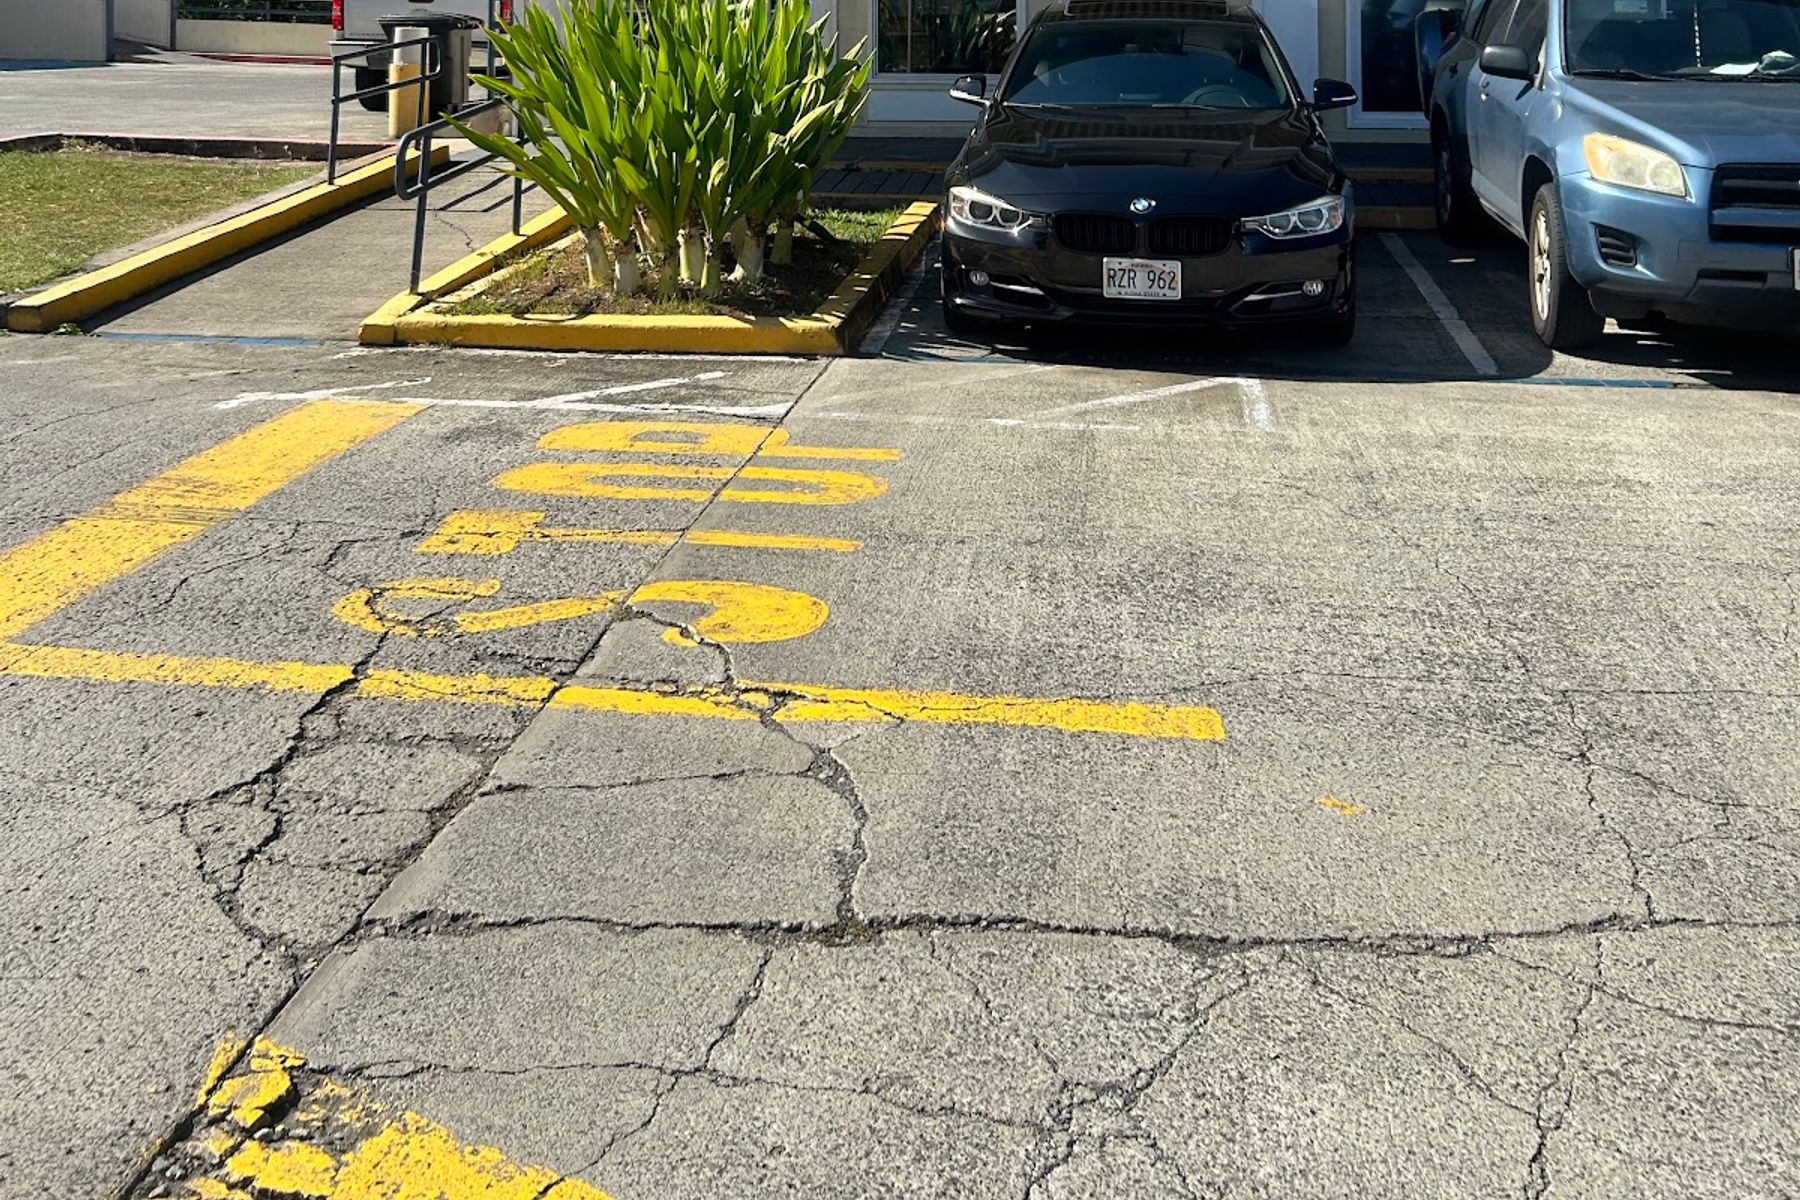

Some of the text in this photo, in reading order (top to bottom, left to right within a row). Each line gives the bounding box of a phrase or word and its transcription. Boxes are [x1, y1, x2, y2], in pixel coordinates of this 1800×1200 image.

[1107, 268, 1177, 290] RZR 962
[331, 420, 900, 648] STOP
